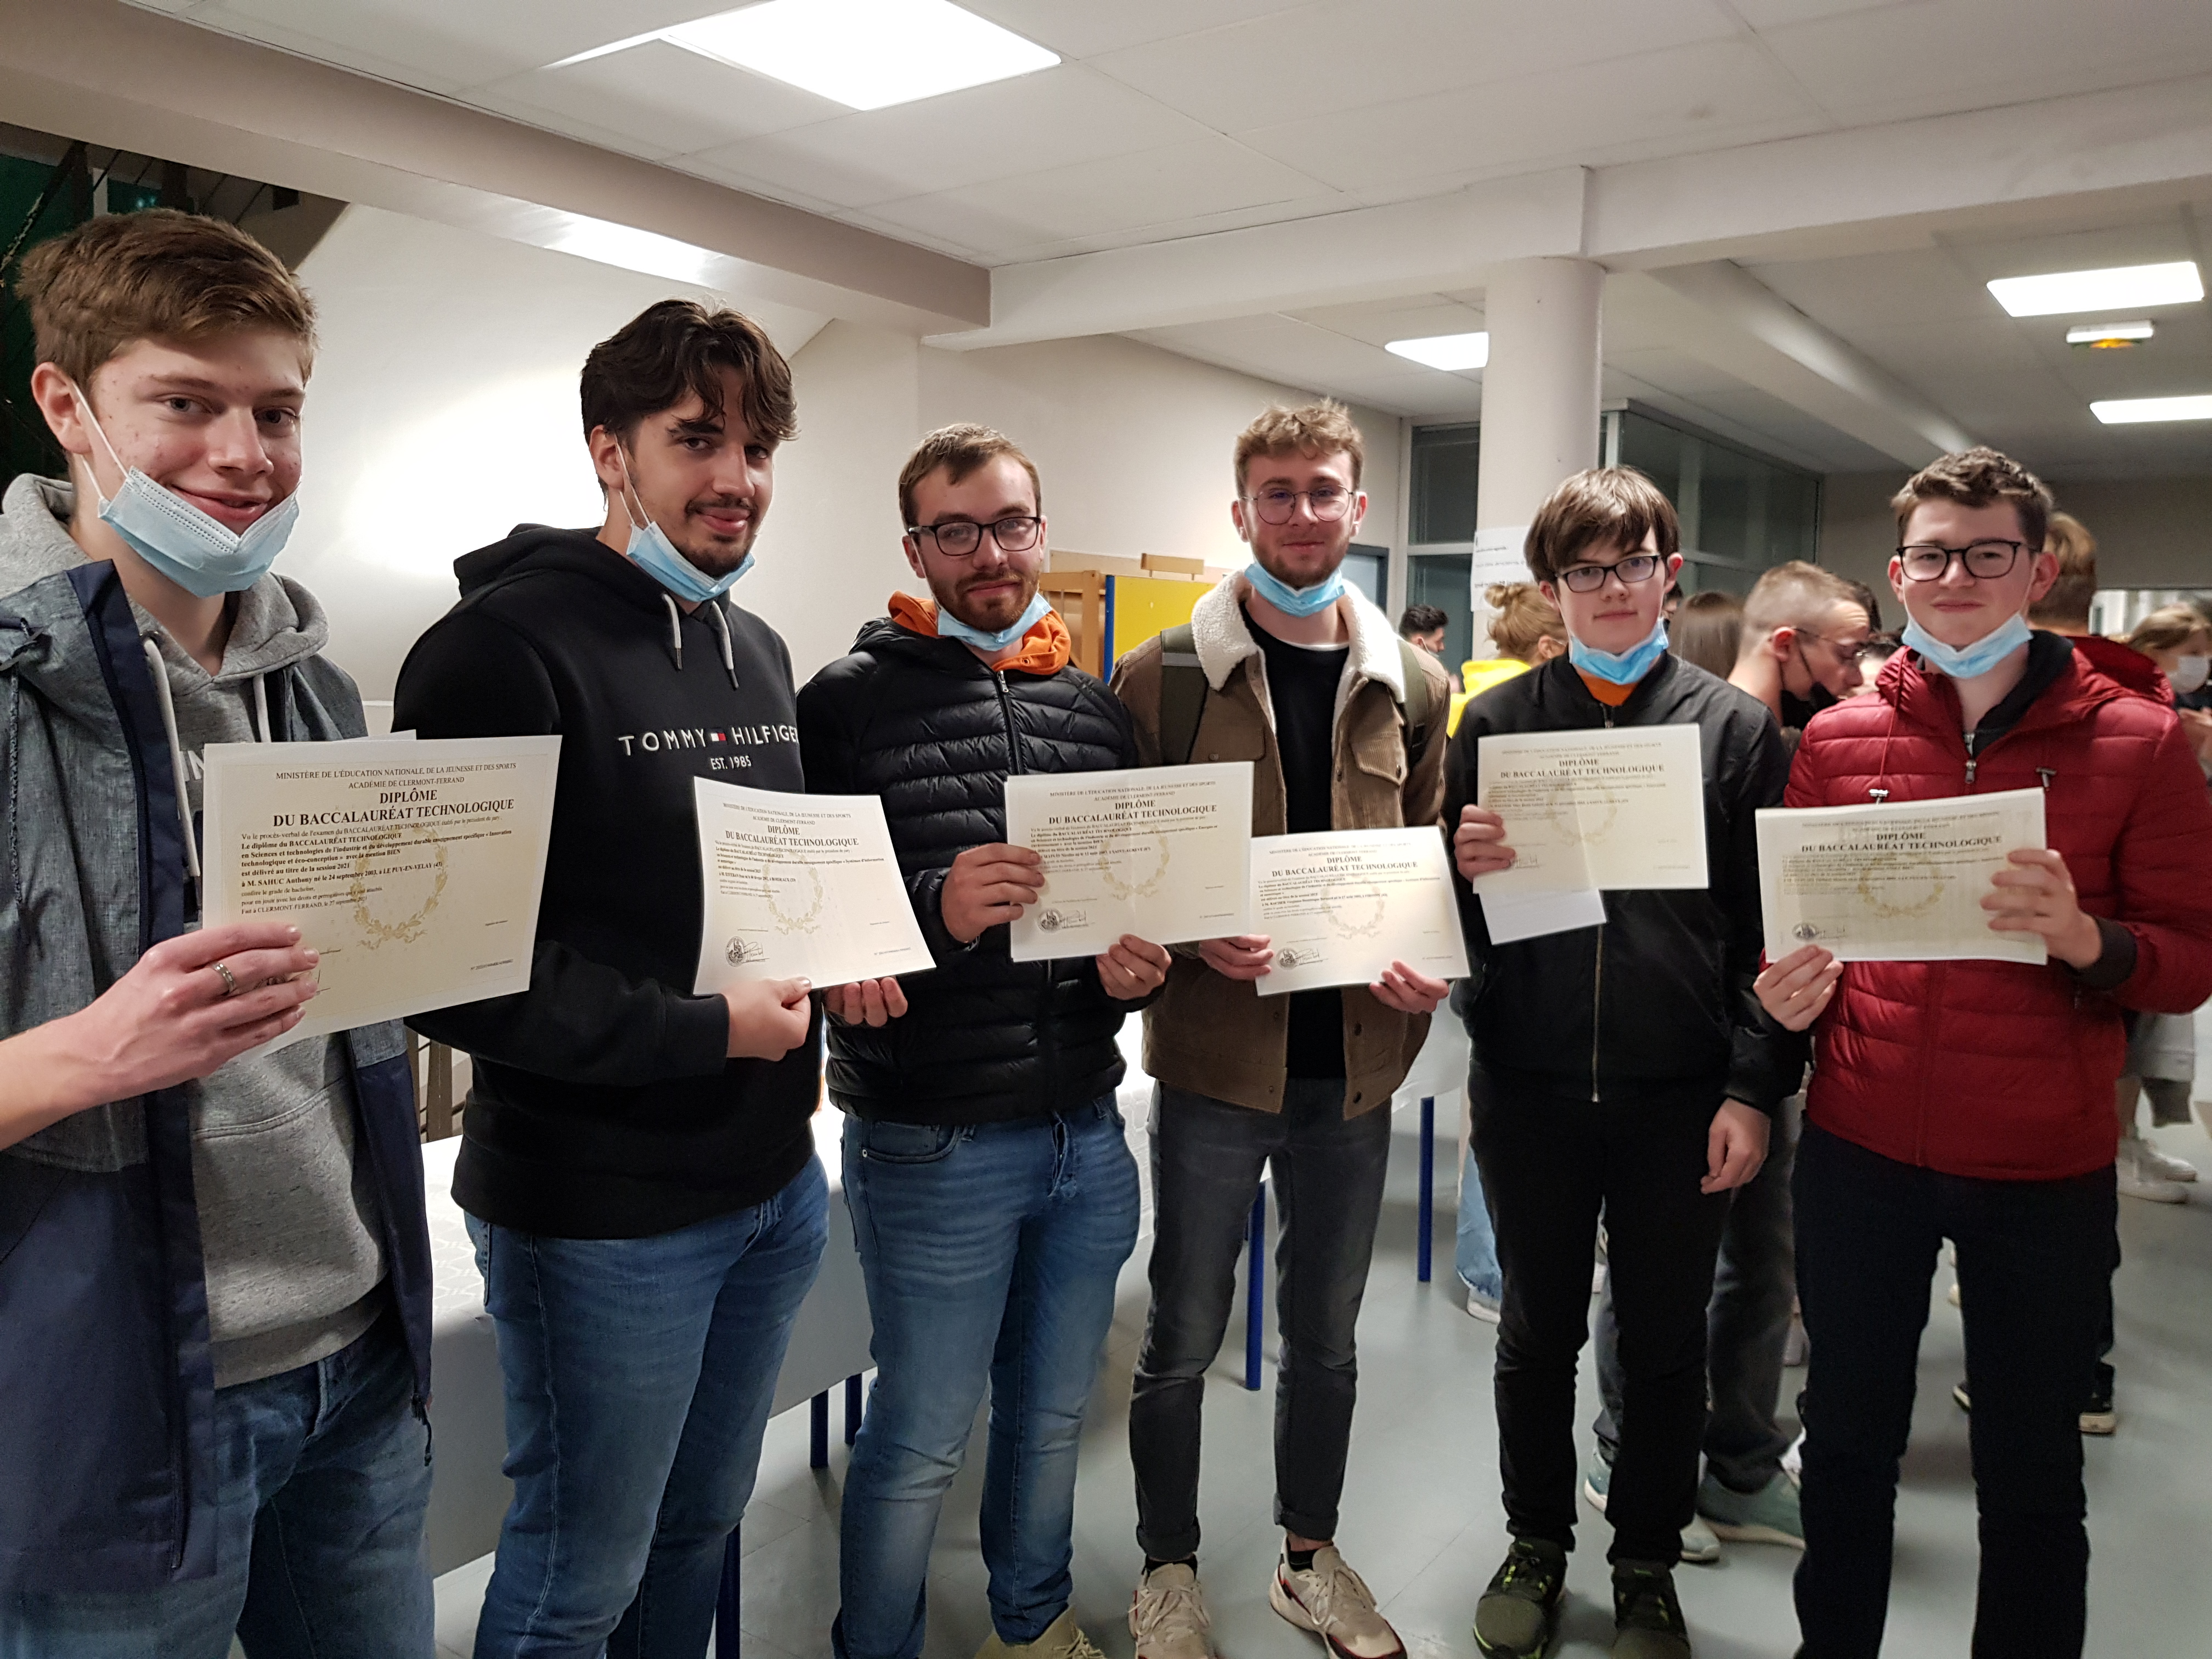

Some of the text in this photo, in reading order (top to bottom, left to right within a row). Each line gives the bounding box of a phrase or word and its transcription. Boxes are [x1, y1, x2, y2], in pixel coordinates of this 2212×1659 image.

[618, 729, 706, 756] TOMMY
[710, 755, 752, 770] EST. 1985
[276, 770, 320, 779] MINISTÈRE
[334, 769, 382, 777] L'ÉDUCATION
[348, 781, 386, 789] ACADÉMIE
[399, 777, 465, 786] CLERMONT-FERRAND
[380, 788, 437, 804] DIPLÔME
[1115, 799, 1155, 810] DIPLÔME
[274, 799, 514, 827] DU BACCALAURÉAT TECHNOLOGIQUE
[1065, 810, 1138, 823] BACCALAURÉAT
[1141, 805, 1217, 819] TECHNOLOGIQUE
[344, 825, 393, 833] BACCALAURÉAT
[394, 820, 442, 830] TECHNOLOGIQUE
[768, 825, 800, 835] DIPLÔME
[251, 842, 278, 850] diplôme
[289, 837, 347, 847] BACCALAURÉAT
[348, 833, 402, 843] TECHNOLOGIQUE
[725, 830, 859, 847] DU BACCALAURÉAT TECHNOLOGIQUE
[1877, 831, 1926, 840] DIPLÔME
[376, 839, 413, 849] développement
[1910, 836, 2001, 849] TECHNOLOGIQUE
[241, 859, 286, 867] technologique
[295, 855, 338, 864] éco-conception
[1327, 855, 1362, 864] DIPLÔME
[336, 872, 364, 881] septembre
[392, 862, 433, 873] PUY-EN-VELAY
[1285, 864, 1349, 876] BACCALAURÉAT
[1351, 861, 1418, 871] TECHNOLOGIQUE
